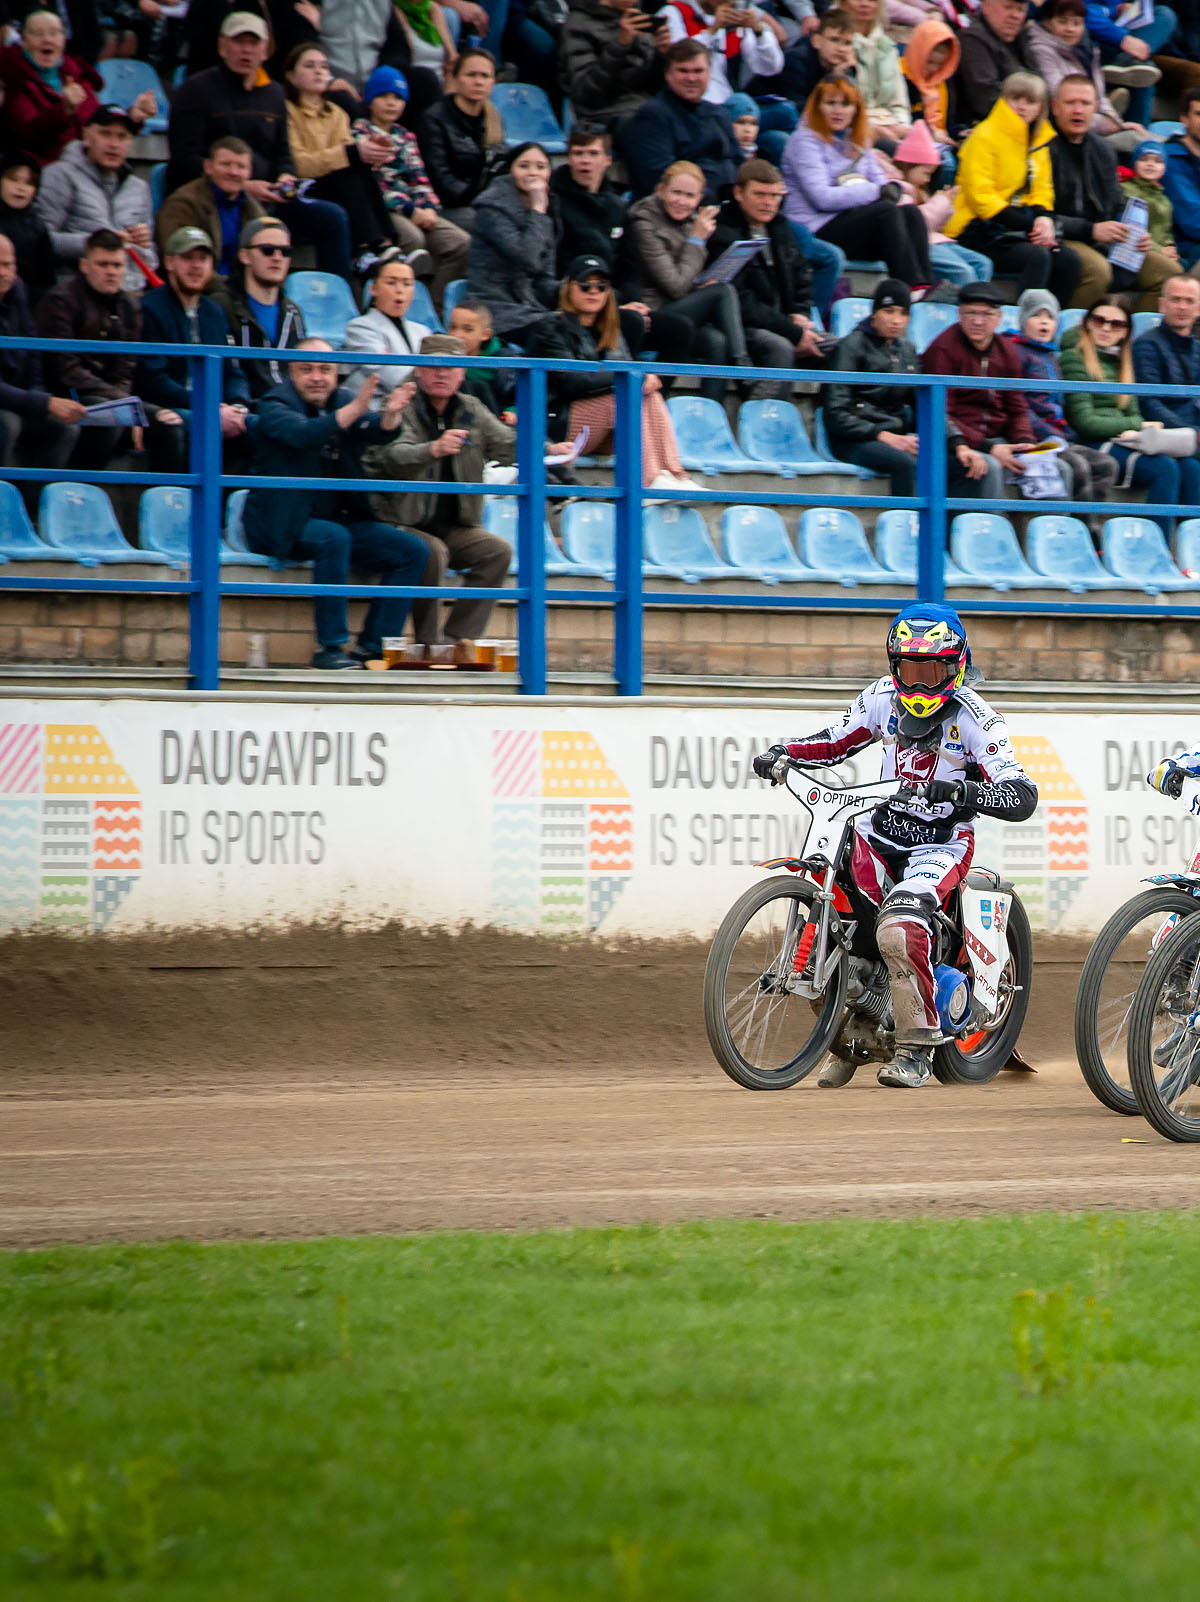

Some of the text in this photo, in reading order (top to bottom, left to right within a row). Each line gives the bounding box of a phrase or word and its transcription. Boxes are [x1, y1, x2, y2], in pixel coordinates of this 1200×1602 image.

[160, 729, 388, 786] DAUGAVPILS
[823, 791, 866, 808] OPTIBET
[160, 810, 325, 865] IR SPORTS
[650, 813, 810, 866] IS SPEEDW
[1105, 815, 1132, 866] IR
[975, 969, 997, 999] LATVIA
